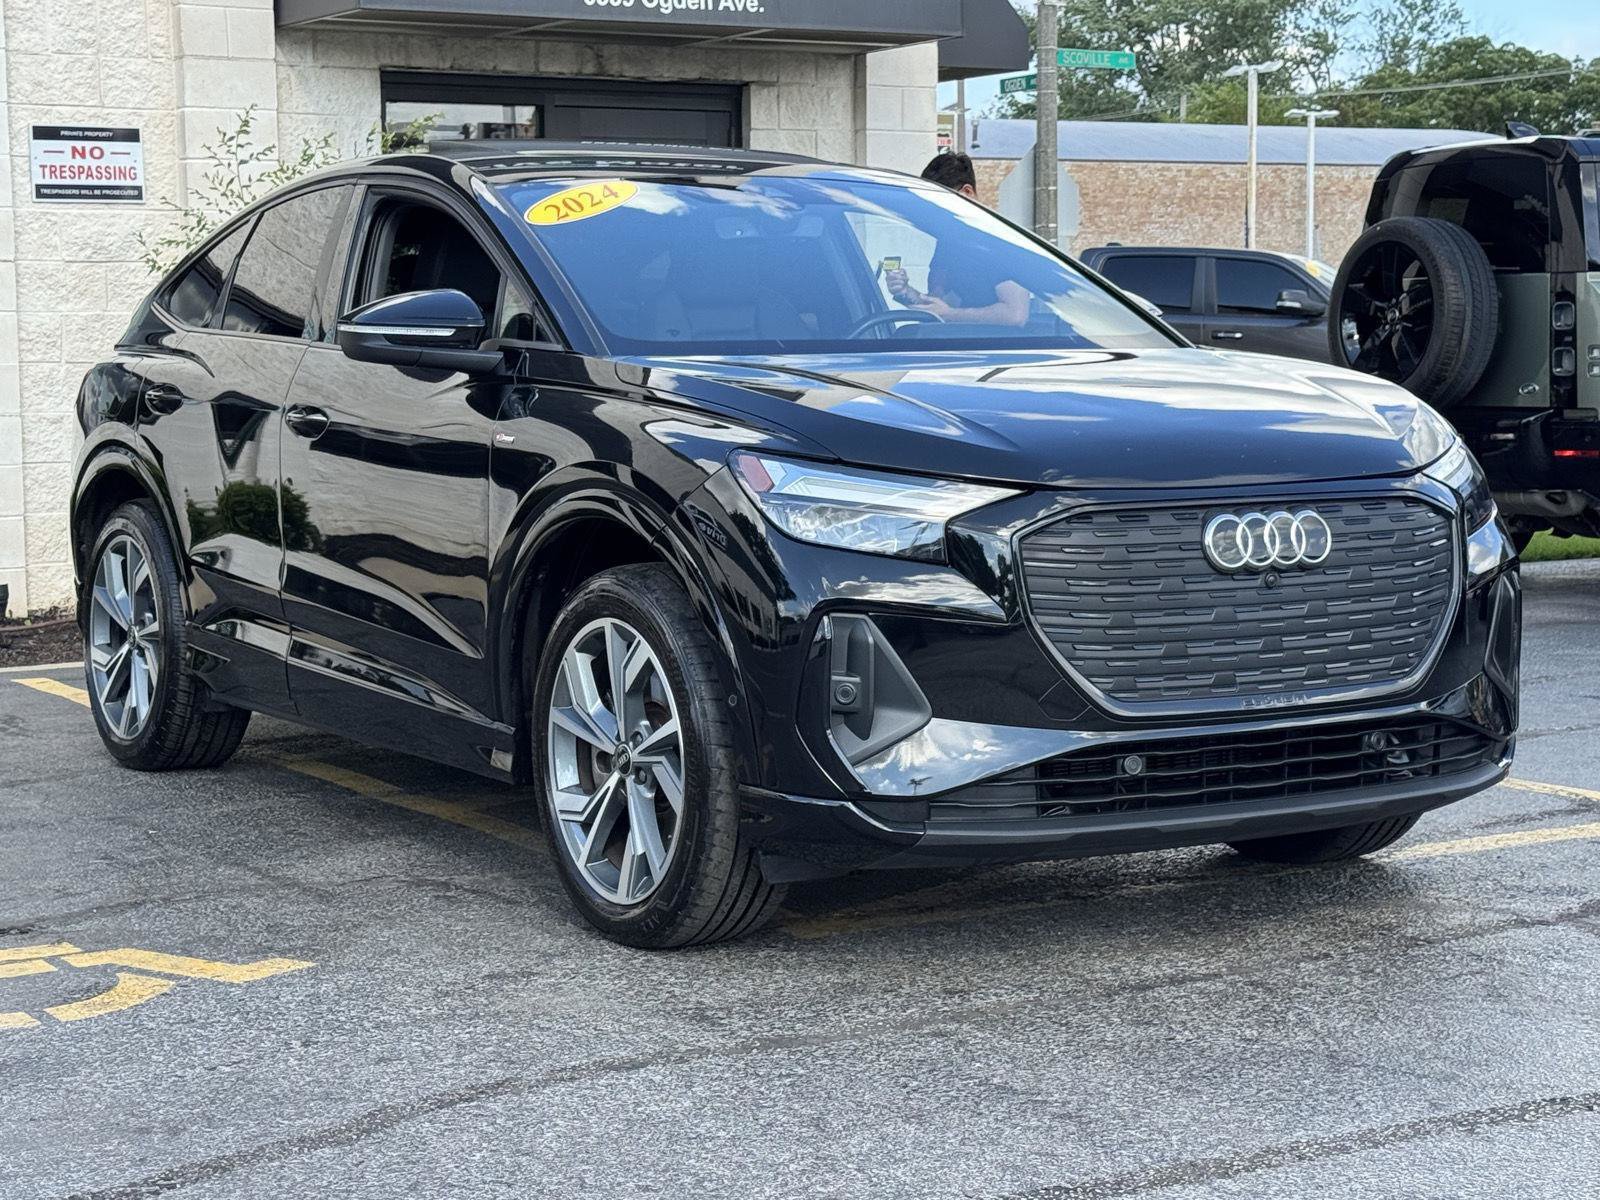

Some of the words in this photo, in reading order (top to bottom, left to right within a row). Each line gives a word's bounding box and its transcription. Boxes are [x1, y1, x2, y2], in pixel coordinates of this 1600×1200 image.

[717, 0, 765, 13] Ave.
[1063, 51, 1111, 66] SCOVILLE
[71, 145, 105, 160] NO
[39, 164, 138, 181] TRESPASSING
[544, 184, 619, 221] 2024
